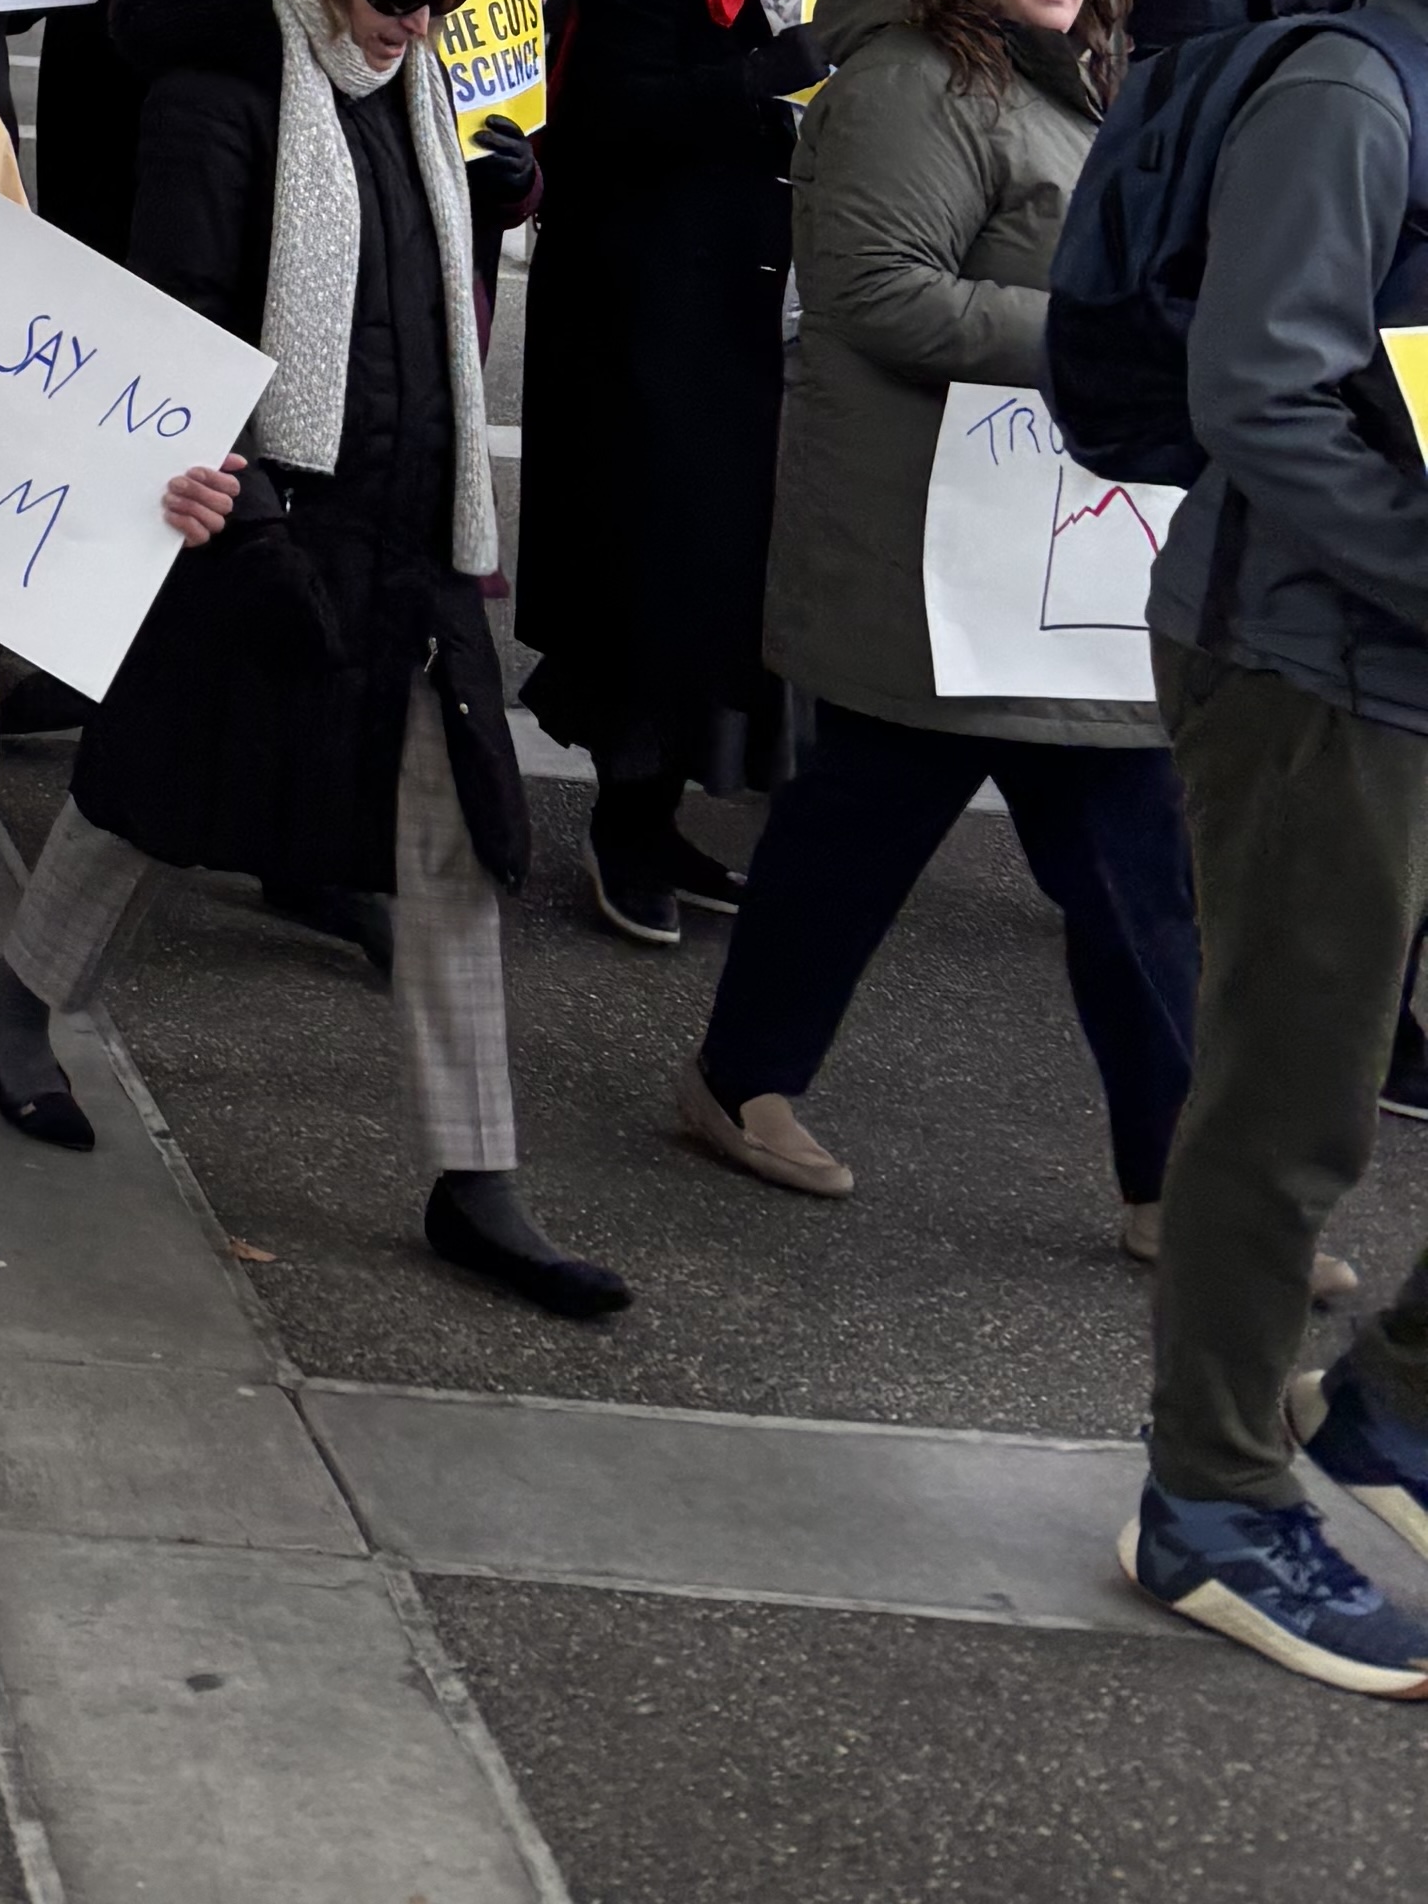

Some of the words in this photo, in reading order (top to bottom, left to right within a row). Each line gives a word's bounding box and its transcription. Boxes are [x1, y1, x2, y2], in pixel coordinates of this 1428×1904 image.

[444, 8, 486, 55] HE
[450, 37, 539, 102] SCIENCE
[98, 376, 191, 438] NO
[967, 398, 1065, 465] TRU
